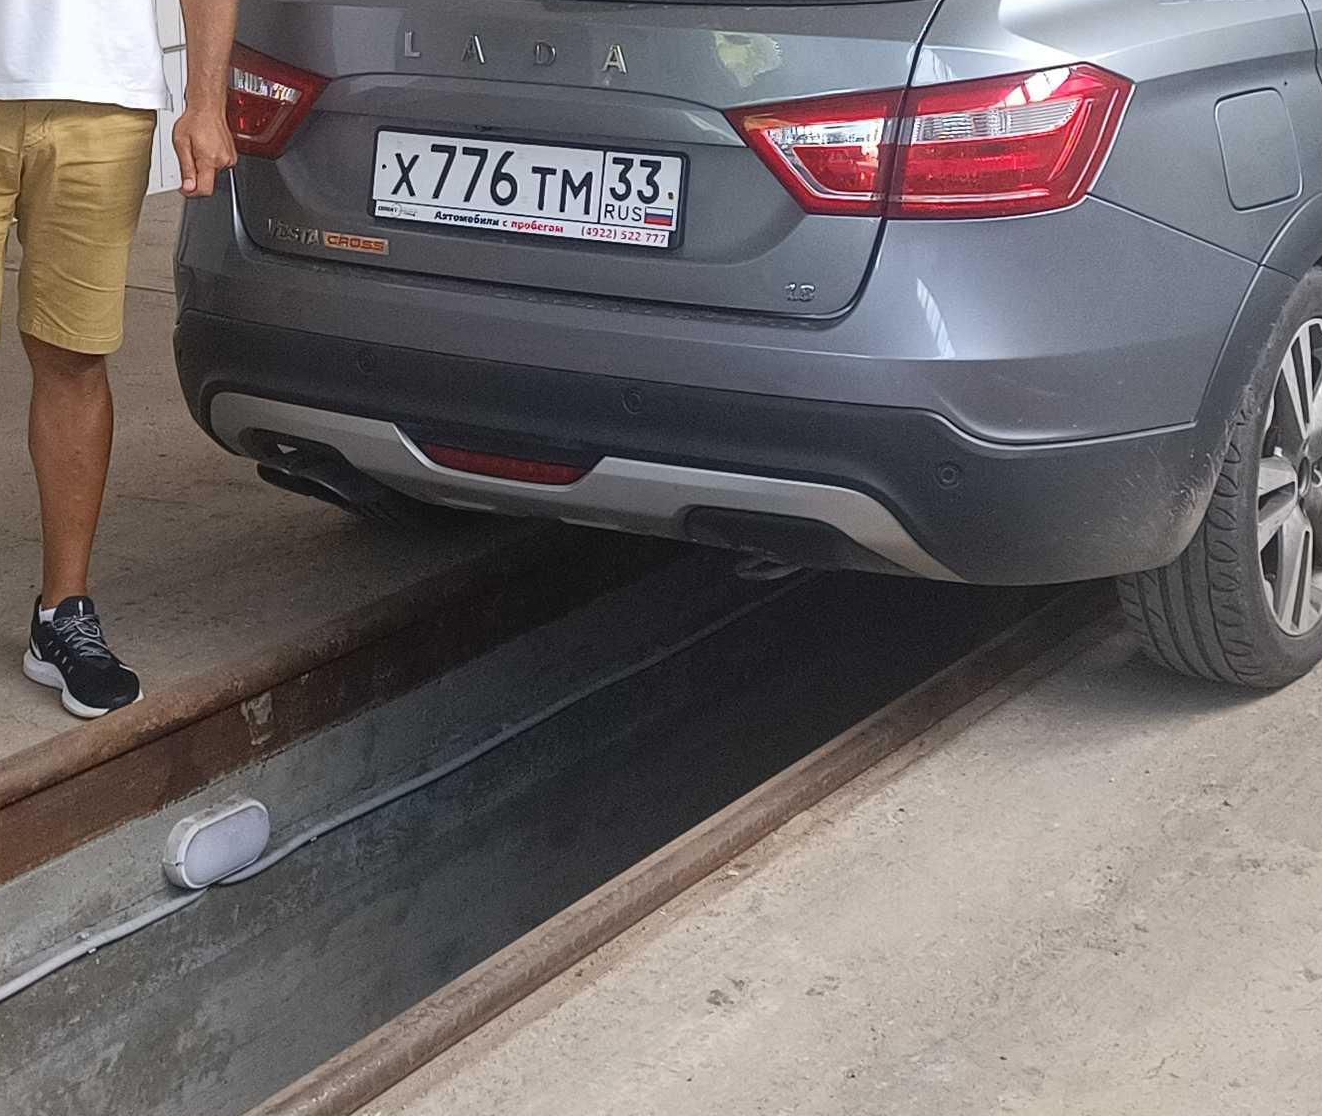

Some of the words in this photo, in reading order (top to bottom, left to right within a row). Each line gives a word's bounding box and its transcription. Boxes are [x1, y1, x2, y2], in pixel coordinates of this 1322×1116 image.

[404, 30, 627, 74] LADA
[609, 157, 662, 204] 33
[434, 210, 500, 227] Автомобили
[511, 218, 564, 234] пробегом
[604, 204, 642, 221] RUS
[267, 218, 320, 245] VESTA
[327, 234, 385, 252] CROSS
[581, 226, 617, 239] (4922)
[620, 230, 641, 241] 522
[645, 233, 666, 244] 777
